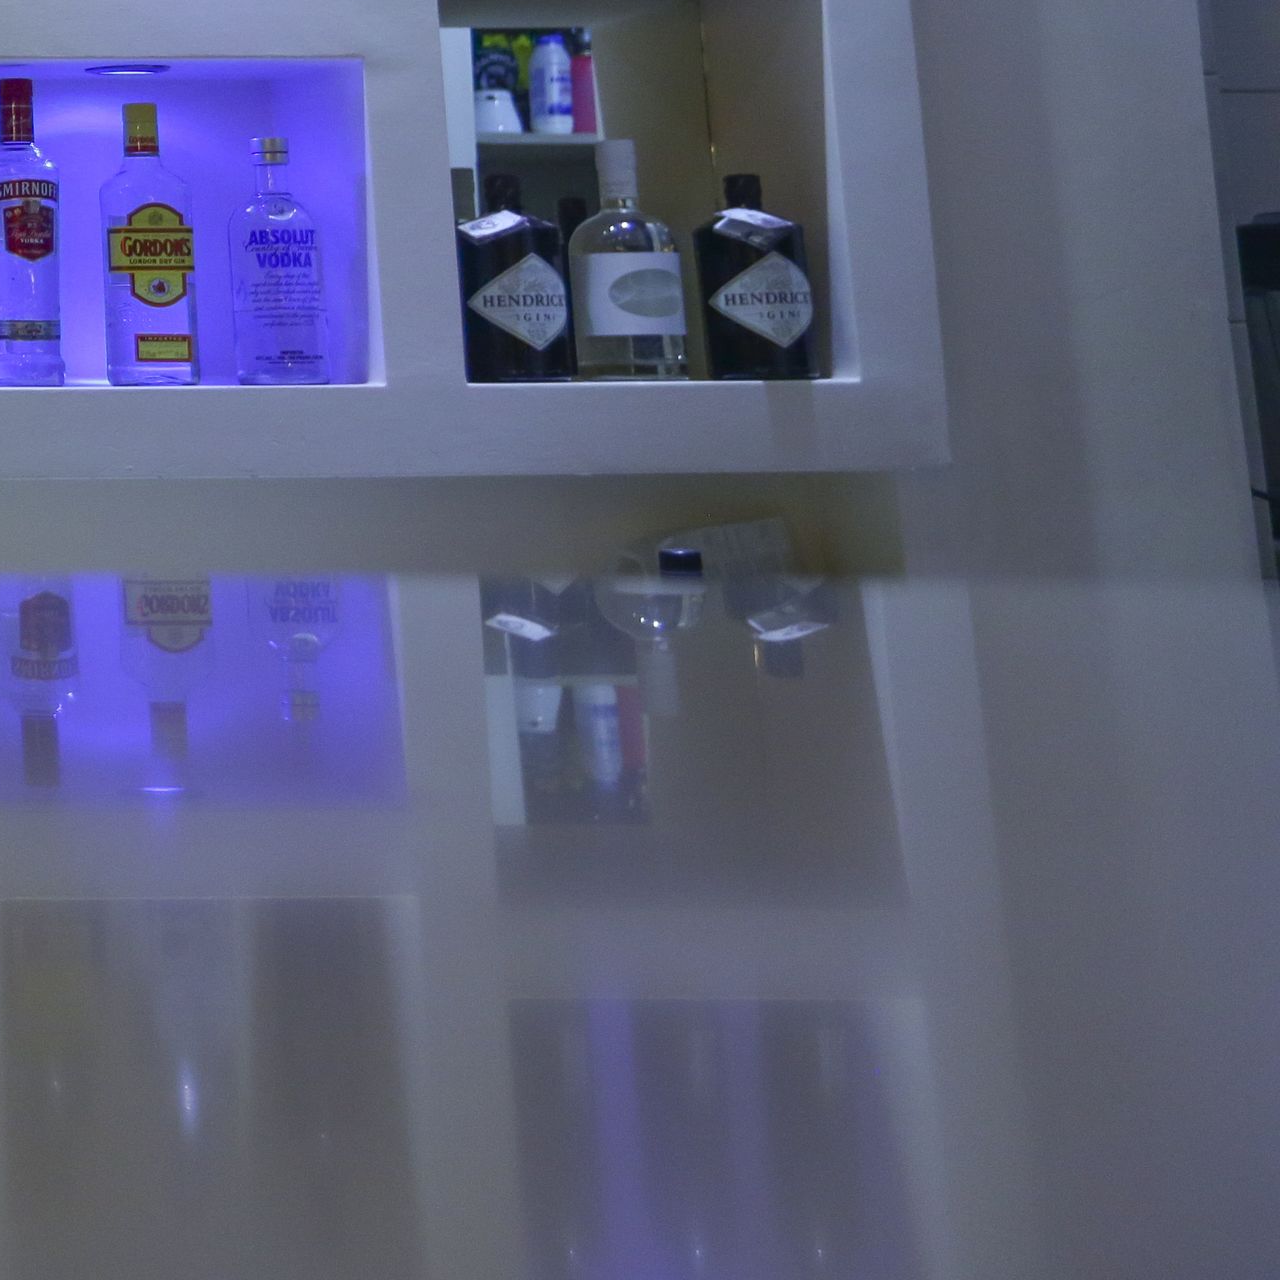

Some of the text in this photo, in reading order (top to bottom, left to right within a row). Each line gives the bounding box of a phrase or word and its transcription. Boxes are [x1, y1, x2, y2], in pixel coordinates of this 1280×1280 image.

[248, 229, 316, 246] ABSOLUT
[256, 253, 312, 268] VODKA
[524, 313, 552, 321] GIN
[767, 311, 797, 319] GIN
